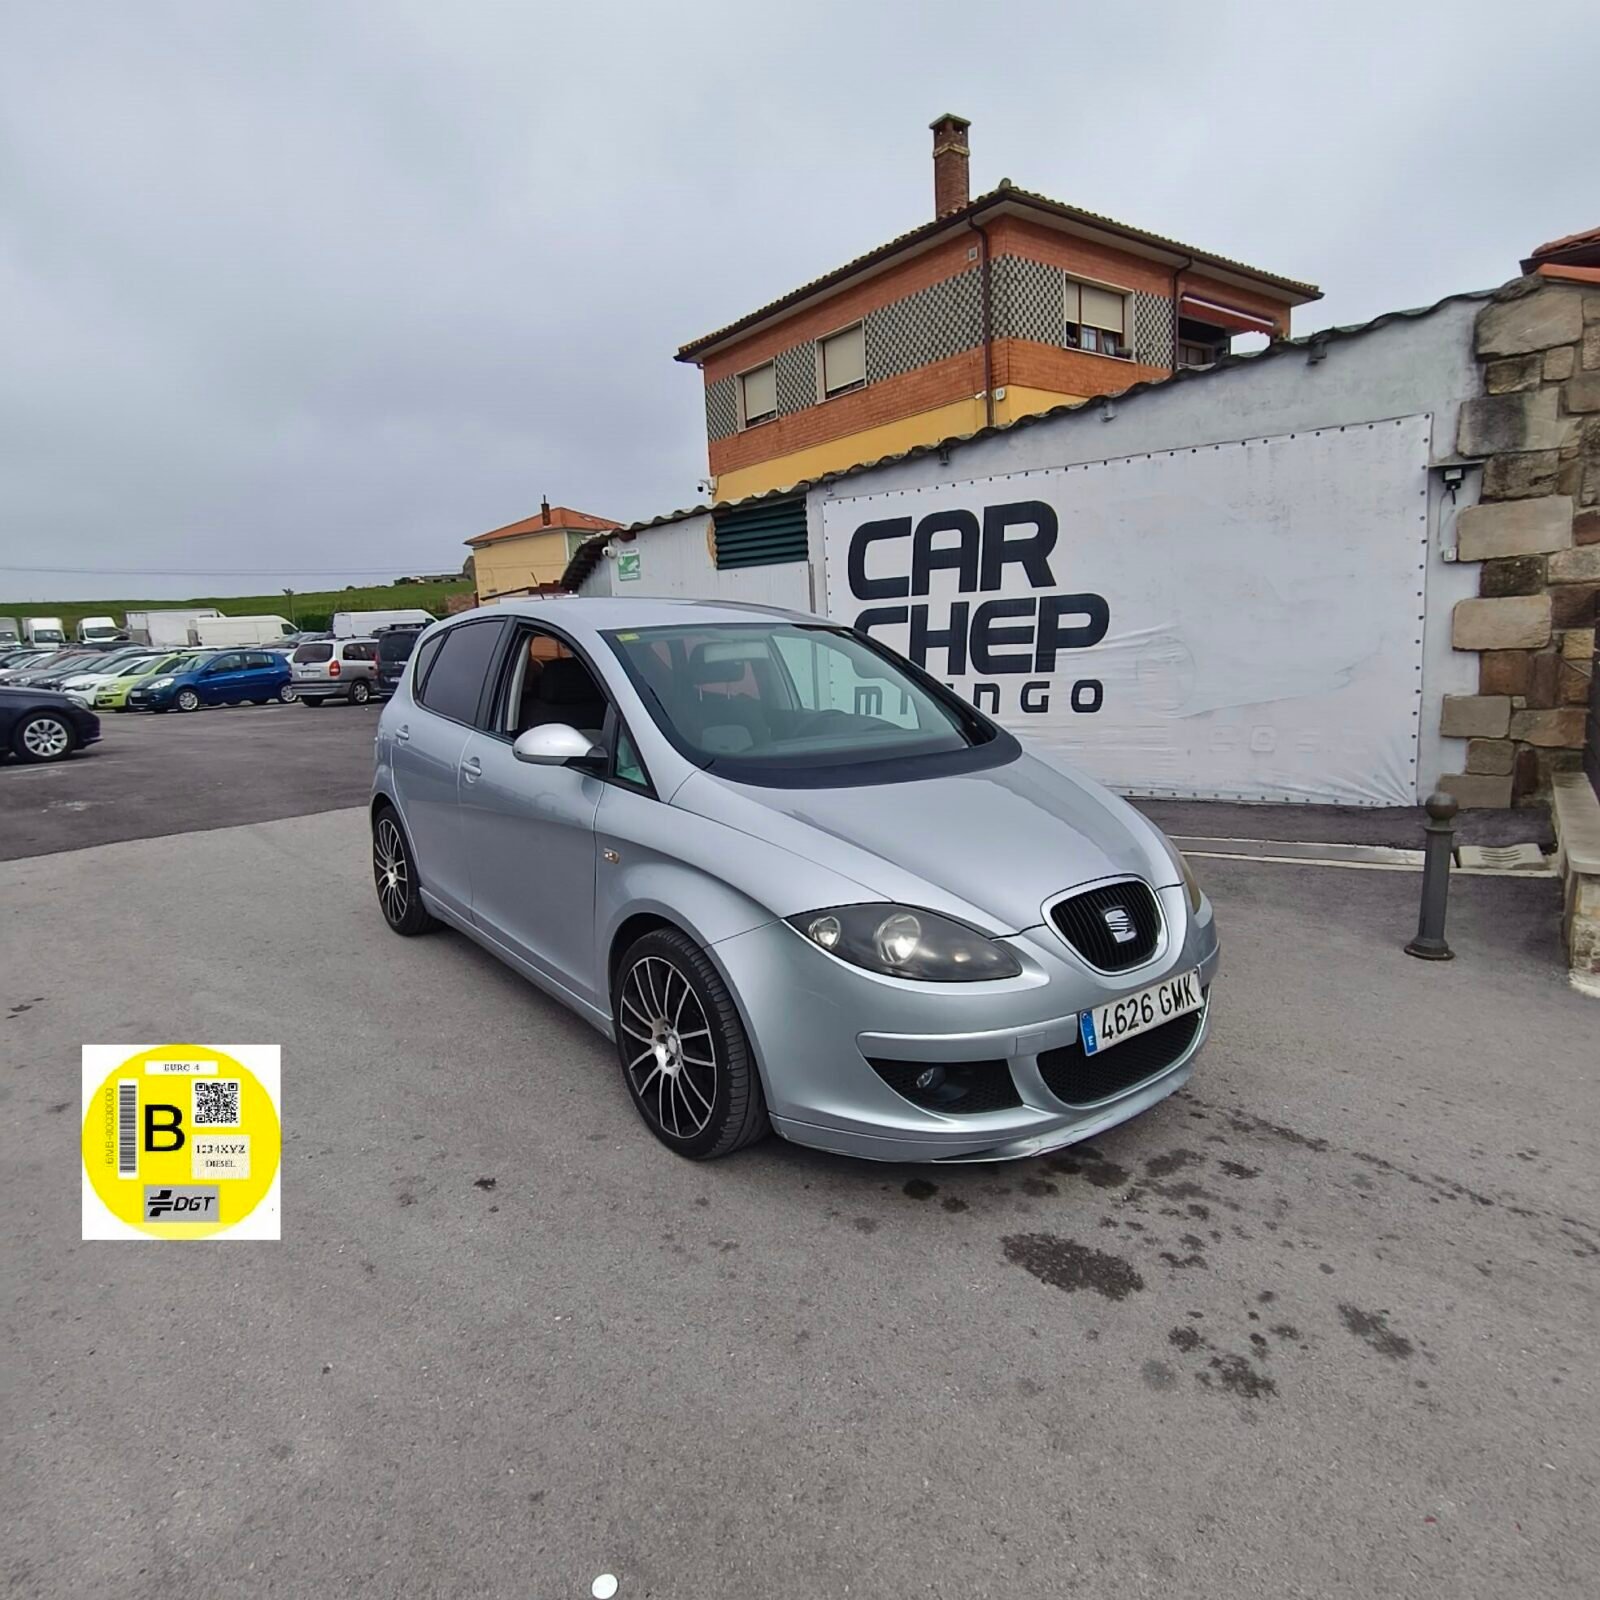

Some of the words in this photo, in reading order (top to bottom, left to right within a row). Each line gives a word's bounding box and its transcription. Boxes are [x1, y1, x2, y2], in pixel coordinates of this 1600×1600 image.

[848, 500, 1058, 600] CAR
[1102, 993, 1154, 1040] 4626
[1158, 974, 1197, 1016] GMK
